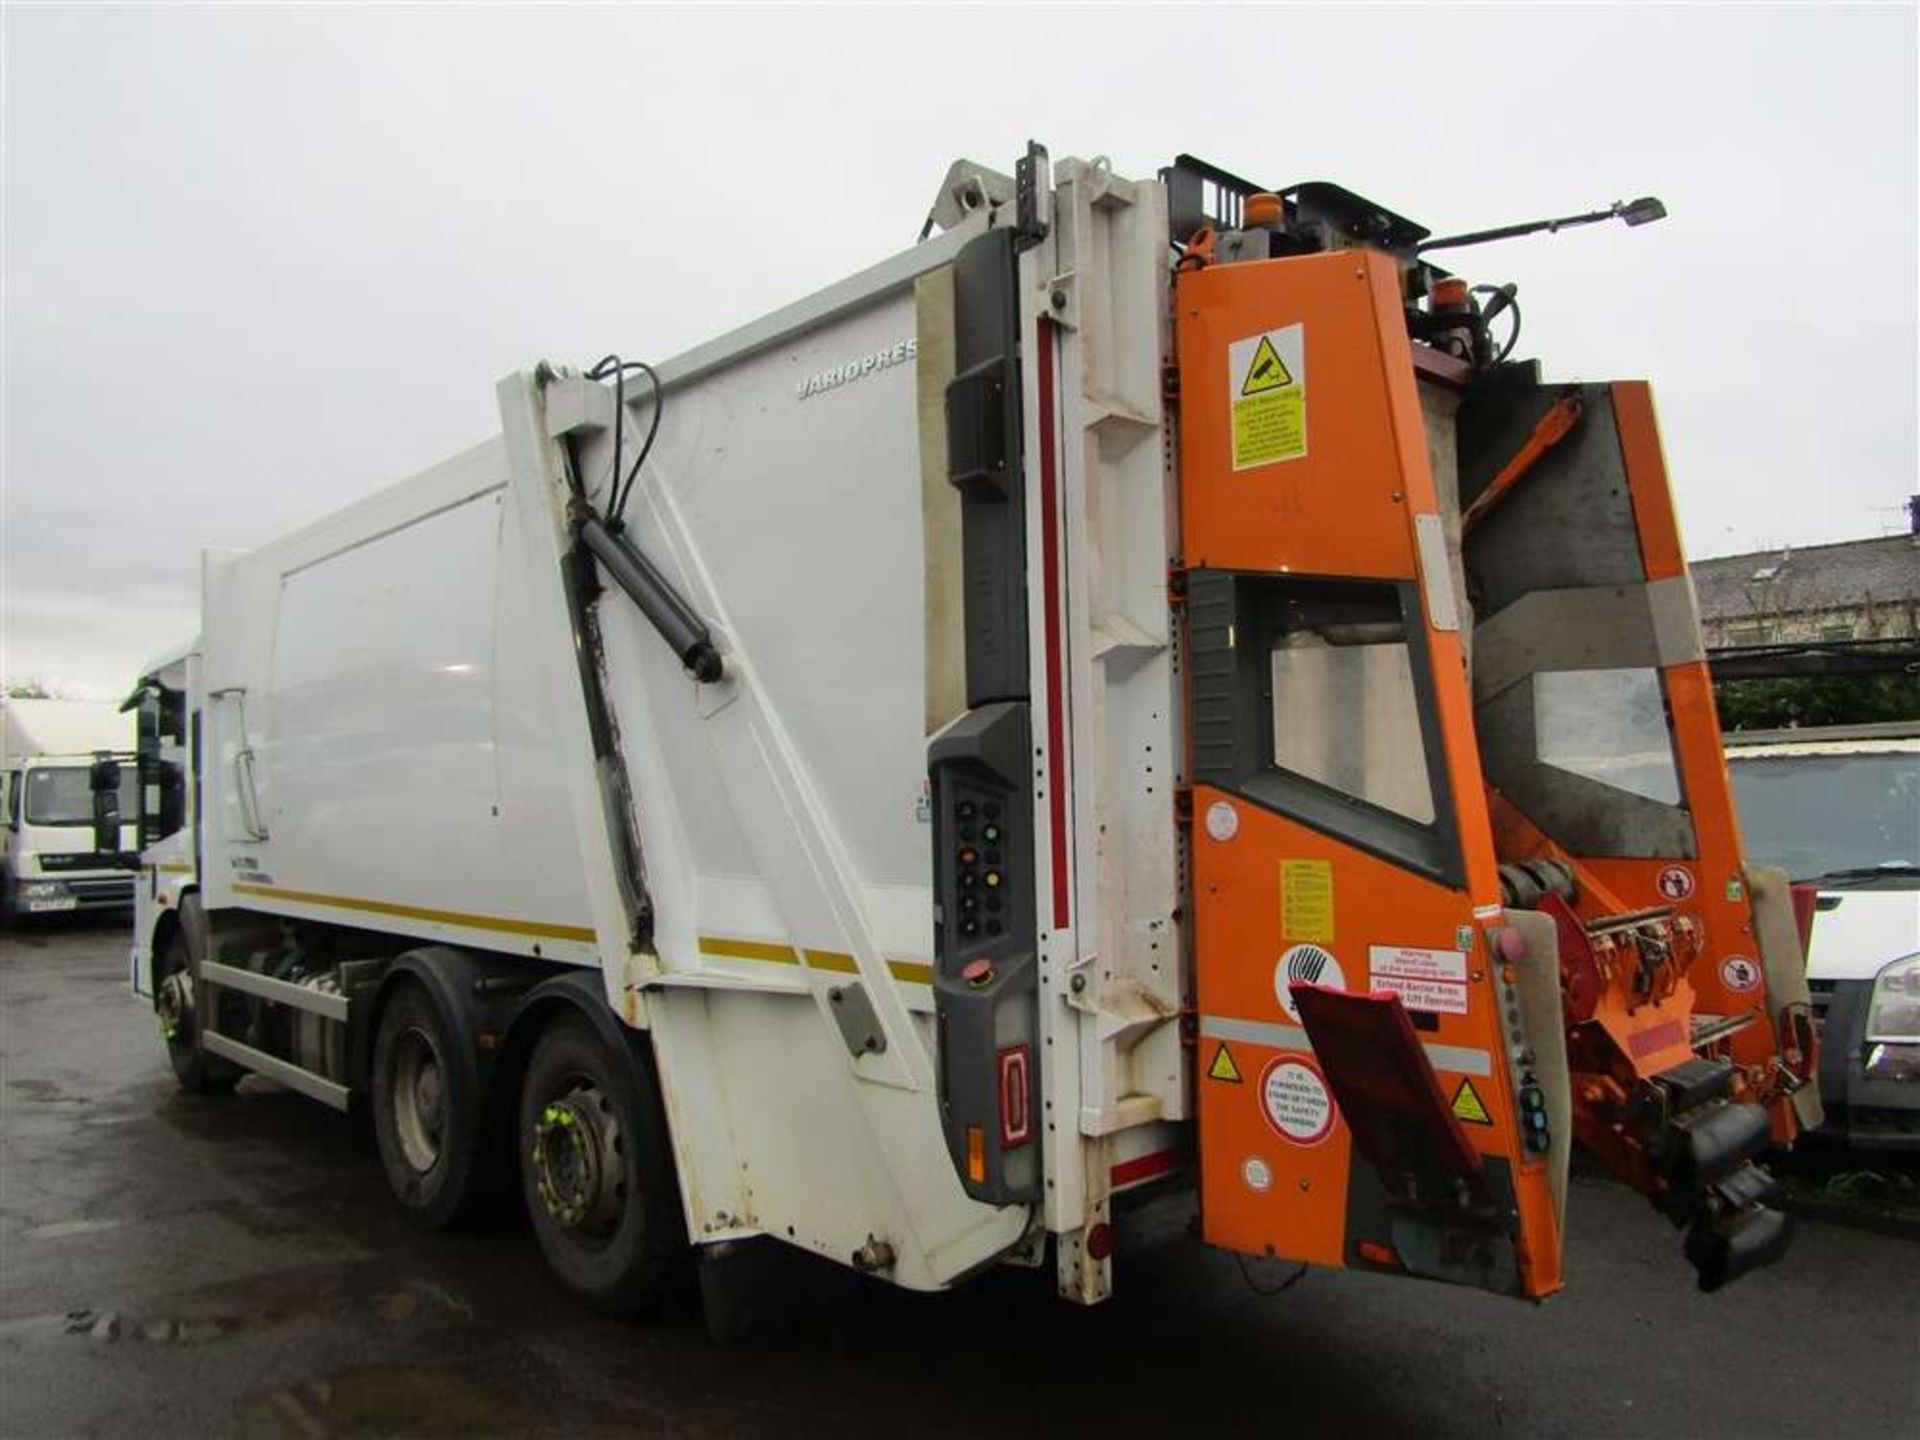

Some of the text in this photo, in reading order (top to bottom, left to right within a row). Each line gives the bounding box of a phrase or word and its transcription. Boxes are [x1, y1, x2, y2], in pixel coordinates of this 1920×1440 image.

[1401, 950, 1432, 960] Warning
[1424, 994, 1466, 1007] Operation
[1292, 1105, 1320, 1117] SAFETY
